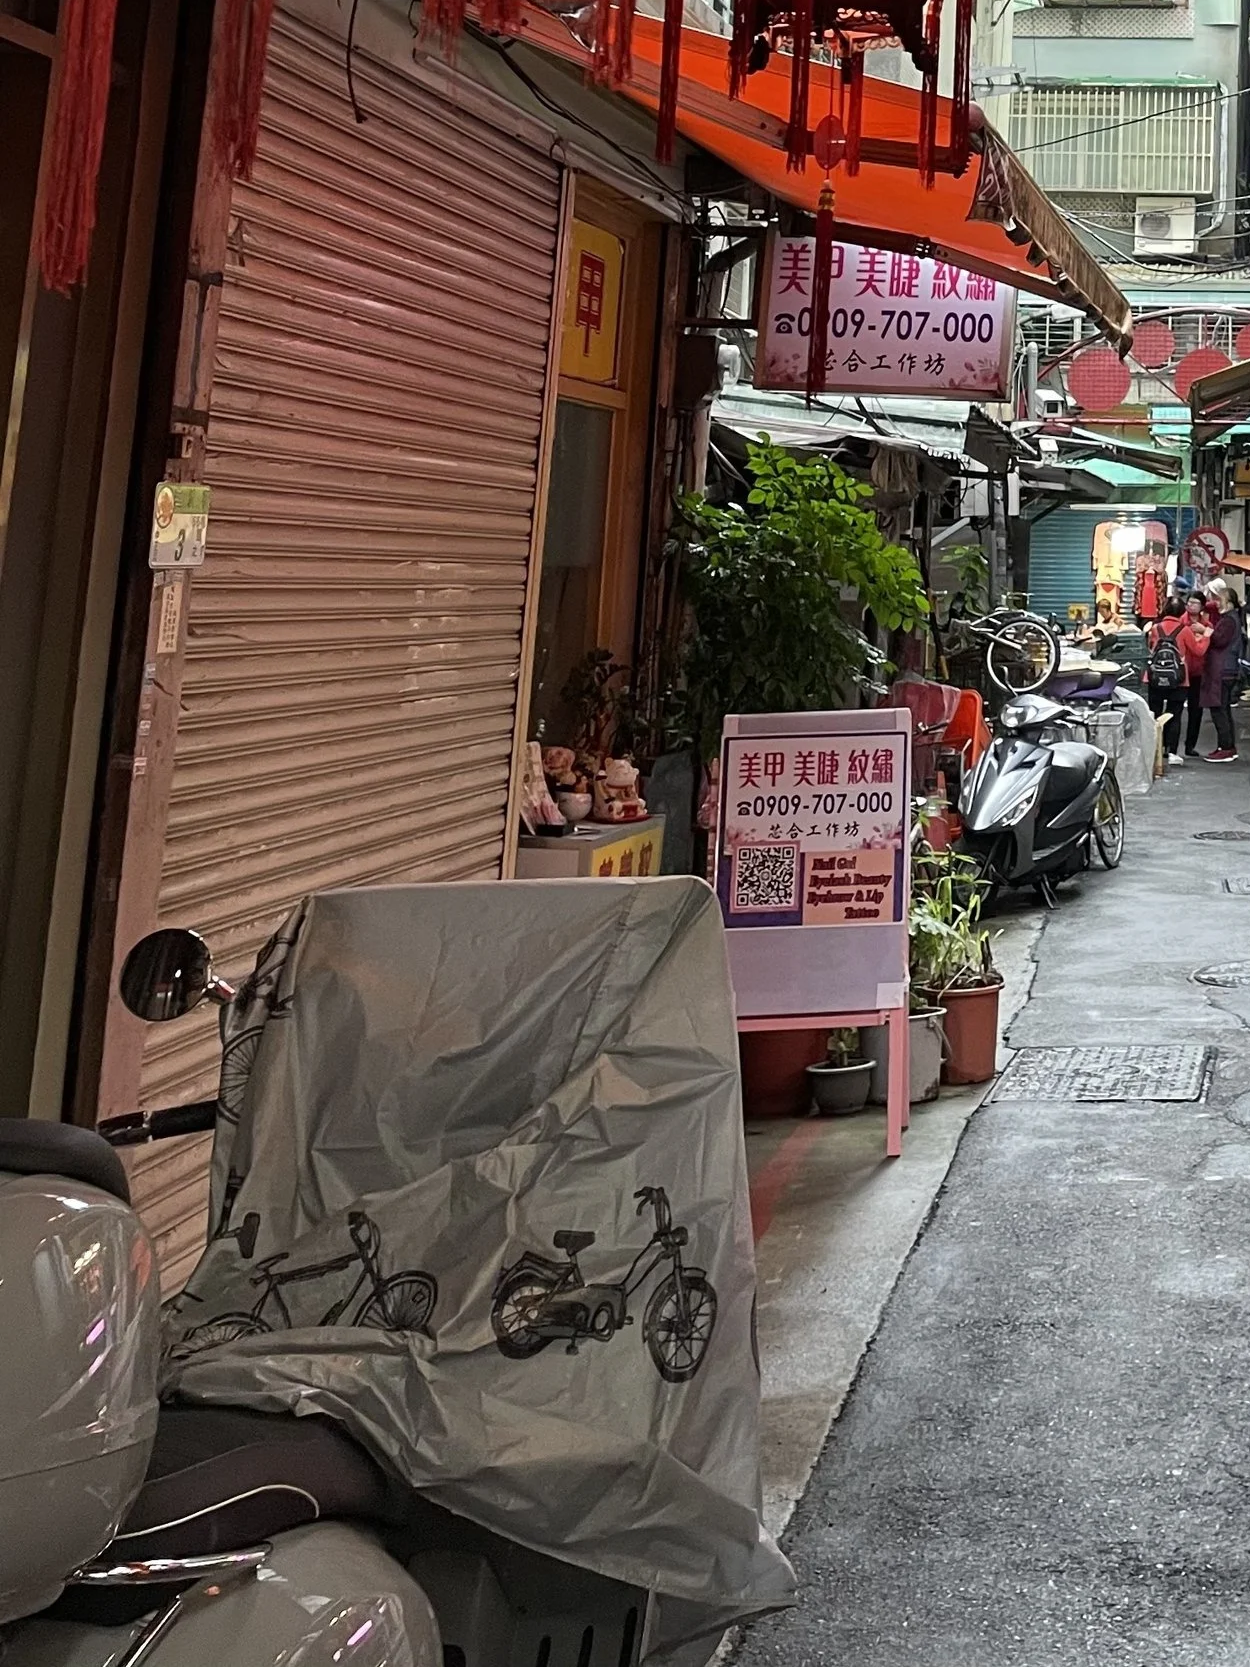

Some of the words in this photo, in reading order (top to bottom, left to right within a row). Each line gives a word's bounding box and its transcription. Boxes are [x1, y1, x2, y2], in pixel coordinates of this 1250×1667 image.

[797, 306, 994, 344] 009-707-000
[739, 752, 785, 789] 美甲
[794, 750, 840, 787] 美睫
[847, 748, 894, 785] 紋繡
[753, 791, 893, 818] 0909-707-000
